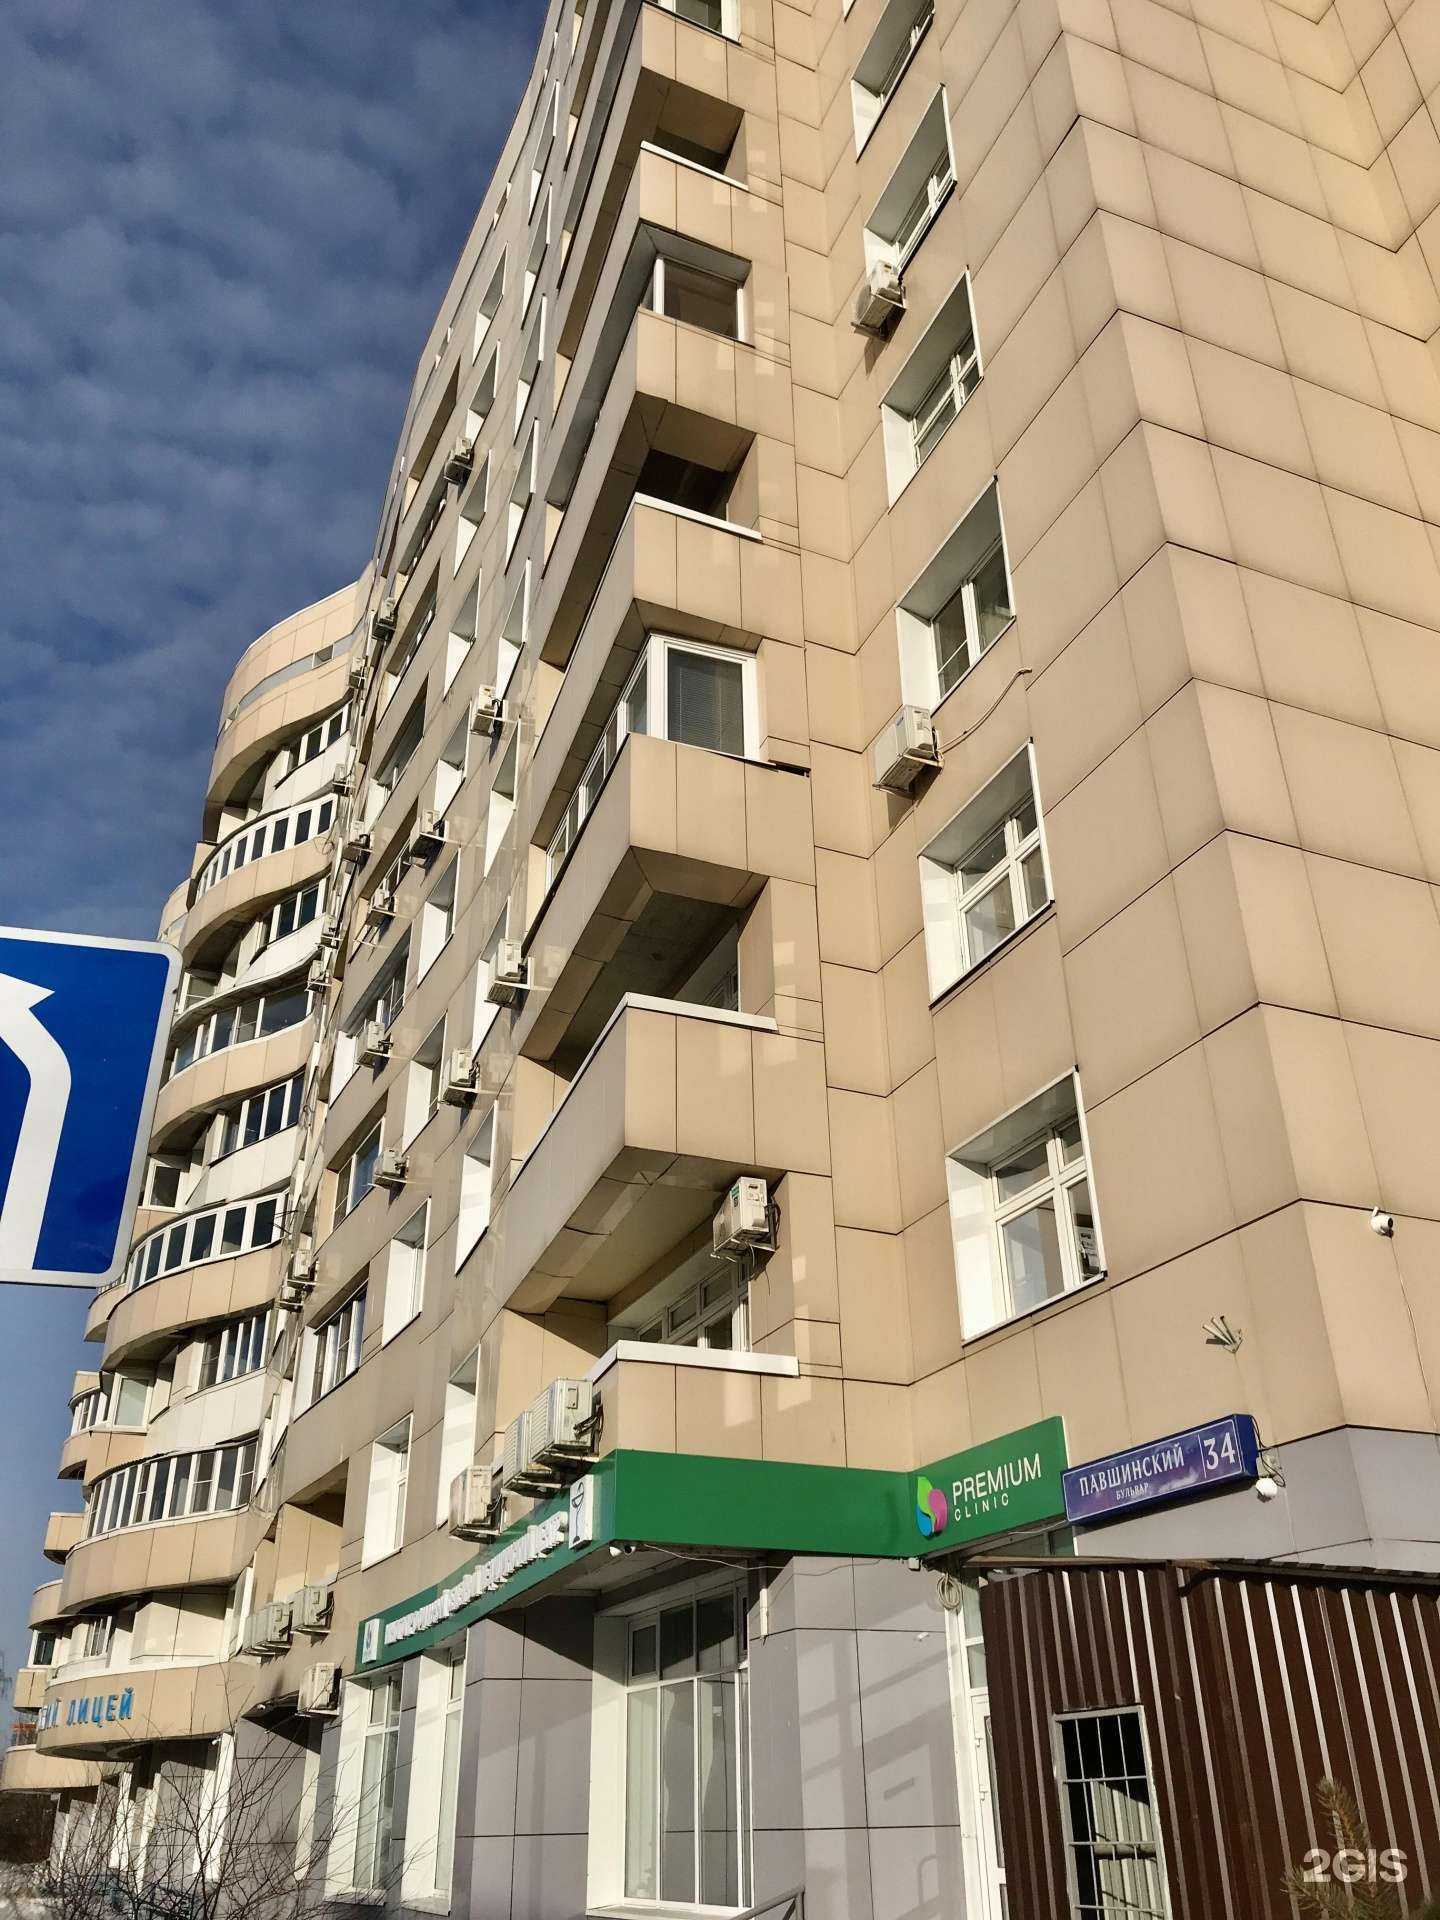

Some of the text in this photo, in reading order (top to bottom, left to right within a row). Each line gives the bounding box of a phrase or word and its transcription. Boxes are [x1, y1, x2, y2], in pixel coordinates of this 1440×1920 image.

[952, 1453, 1042, 1506] PREMIUM
[1079, 1432, 1237, 1498] ПАВШИНСКИЙ 34
[954, 1492, 1010, 1522] CLINIC
[1116, 1482, 1150, 1501] БУЛЬВАР
[66, 1686, 134, 1728] ЛИЦЕЙ
